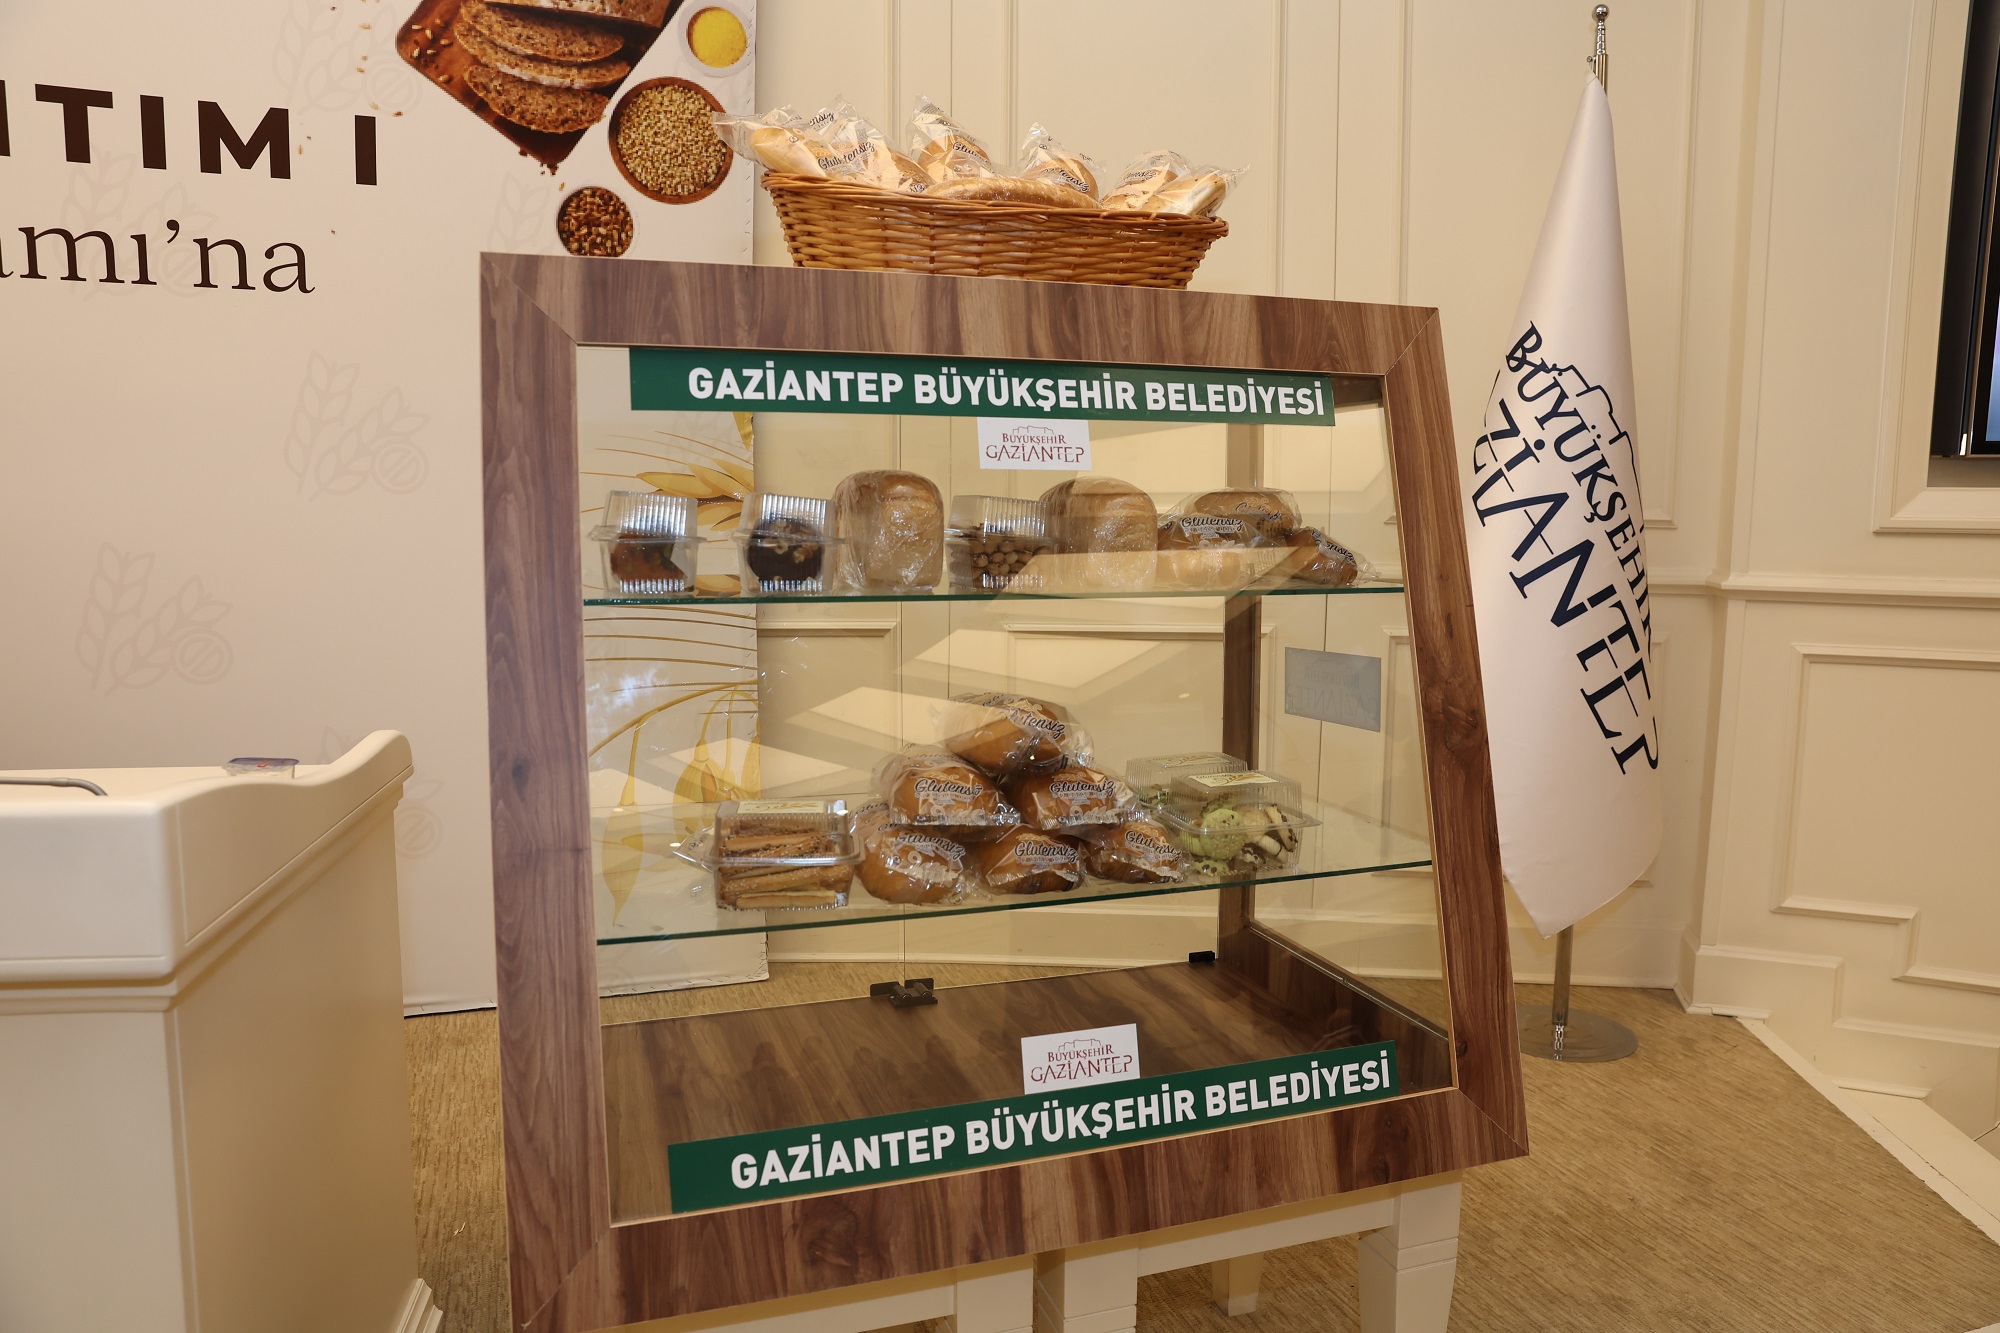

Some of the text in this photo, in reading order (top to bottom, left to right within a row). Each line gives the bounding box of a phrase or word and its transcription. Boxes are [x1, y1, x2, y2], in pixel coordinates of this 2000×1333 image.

[688, 360, 1325, 416] GAZİANTEP BÜYÜKŞEHİR BELEDİYESİ
[1002, 432, 1068, 445] BÜYÜKŞEHİR
[985, 443, 1085, 463] GAZİANTEP
[1181, 516, 1244, 531] Glutensiz
[1050, 780, 1116, 796] Glutensiz
[1014, 841, 1080, 863] Glutensiz
[1047, 1043, 1115, 1063] BÜYÜKŞEHİR
[1030, 1054, 1133, 1084] GAZİANTEP
[731, 1050, 1390, 1189] GAZİANTEP BÜYÜKŞEHİR BELEDİYESİ
